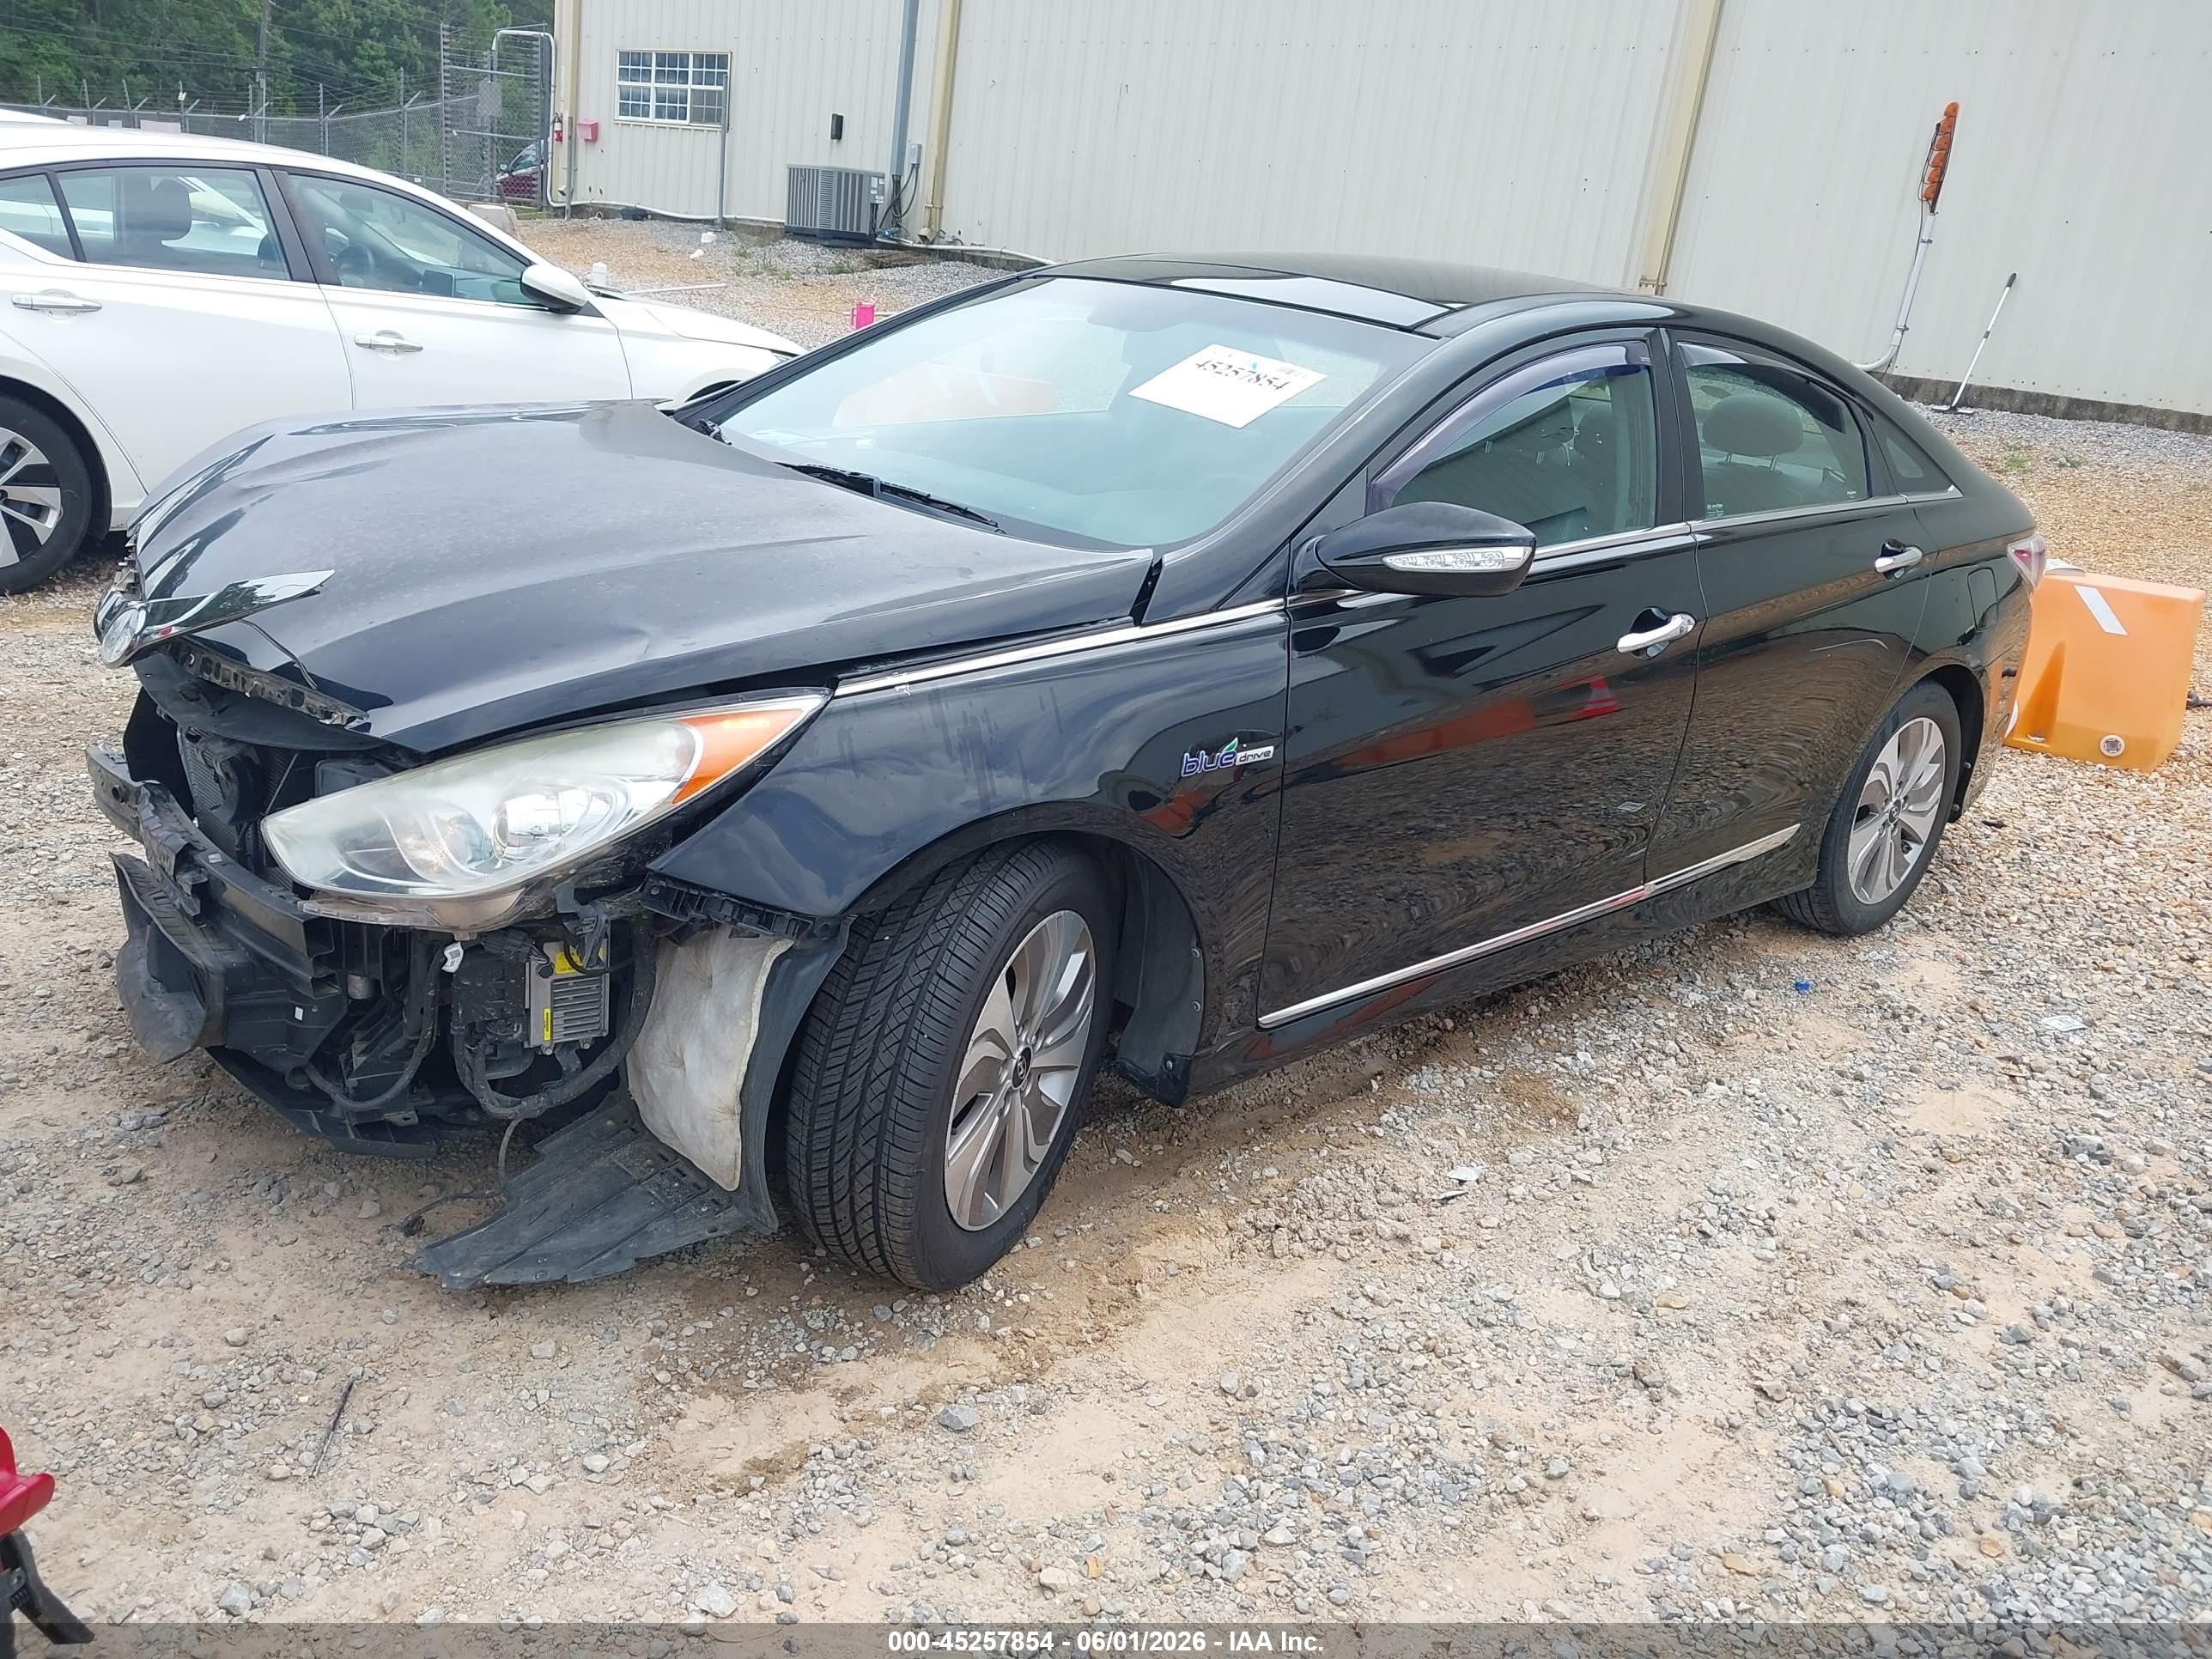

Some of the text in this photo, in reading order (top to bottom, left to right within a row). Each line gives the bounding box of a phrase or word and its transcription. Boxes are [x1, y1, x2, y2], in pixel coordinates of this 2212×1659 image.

[1194, 360, 1291, 390] 45257854
[1182, 749, 1273, 777] blue drive
